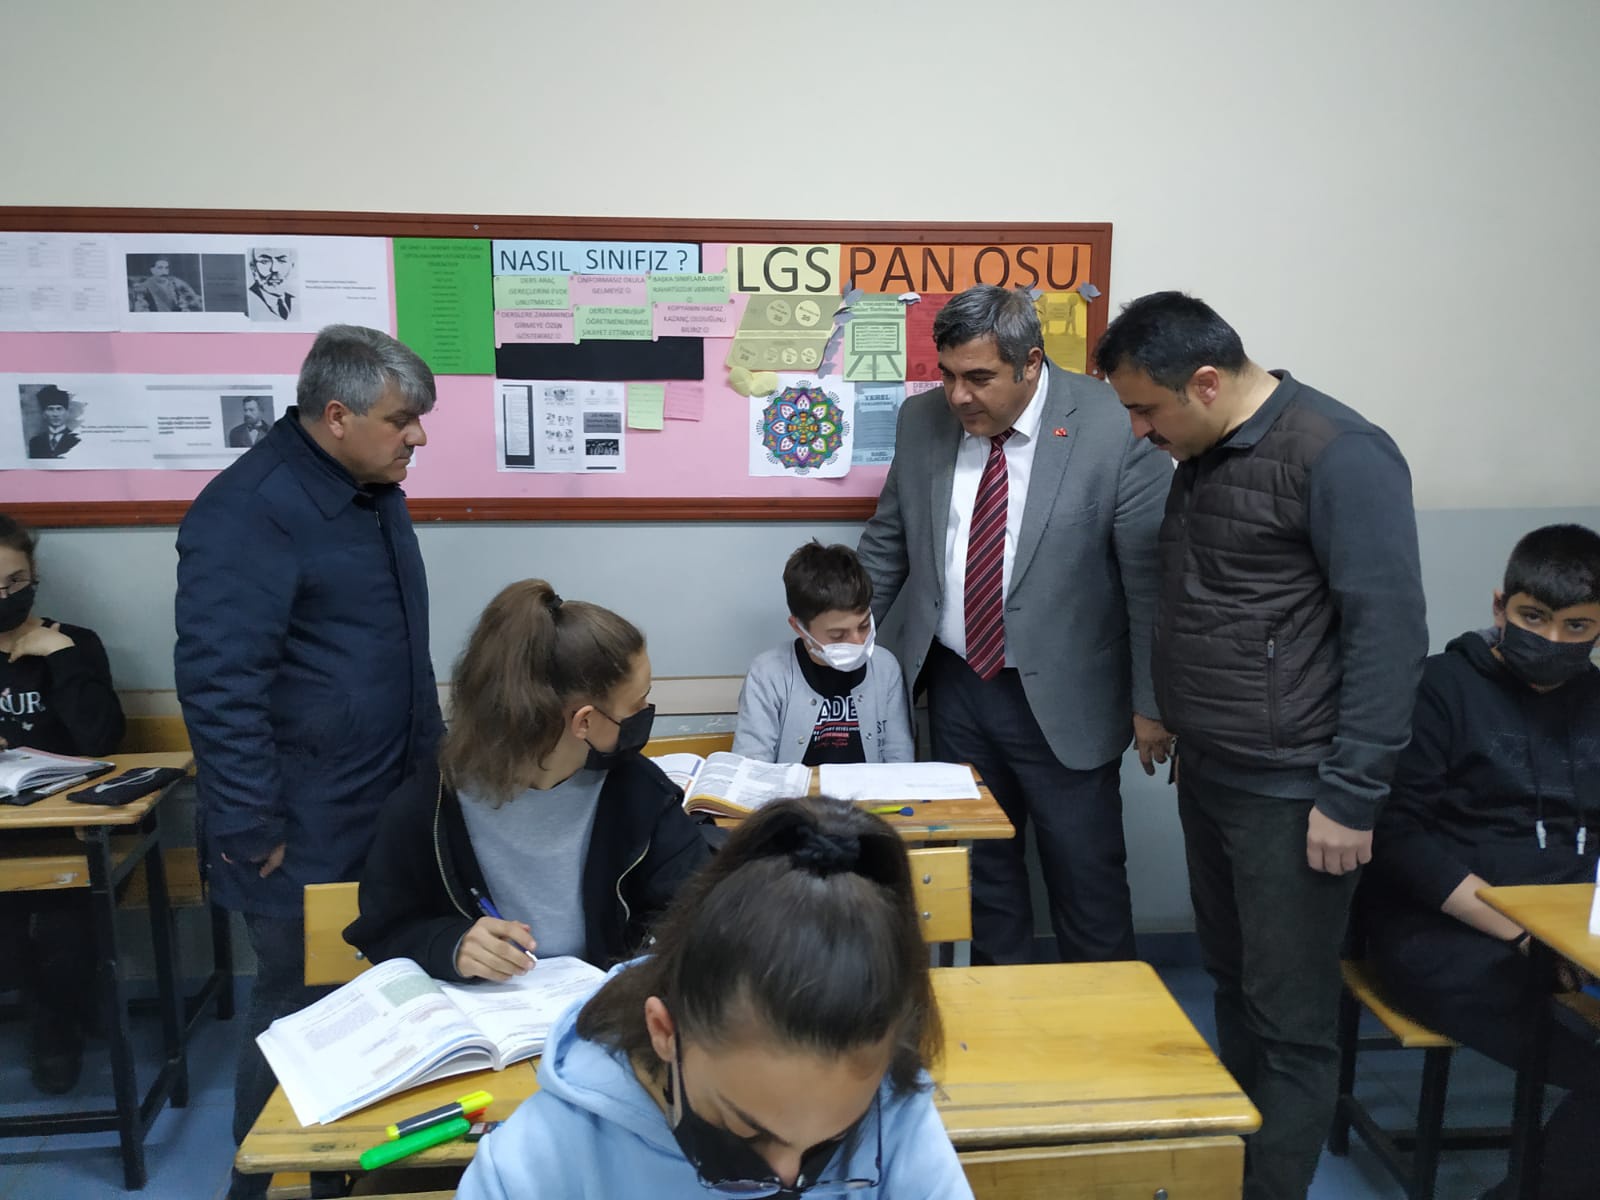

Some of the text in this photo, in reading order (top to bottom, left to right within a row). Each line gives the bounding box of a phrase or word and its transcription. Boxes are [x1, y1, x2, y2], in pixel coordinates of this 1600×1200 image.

[500, 250, 570, 271] NASIL
[586, 249, 668, 270] SINIFIZ
[737, 246, 831, 293] LGS
